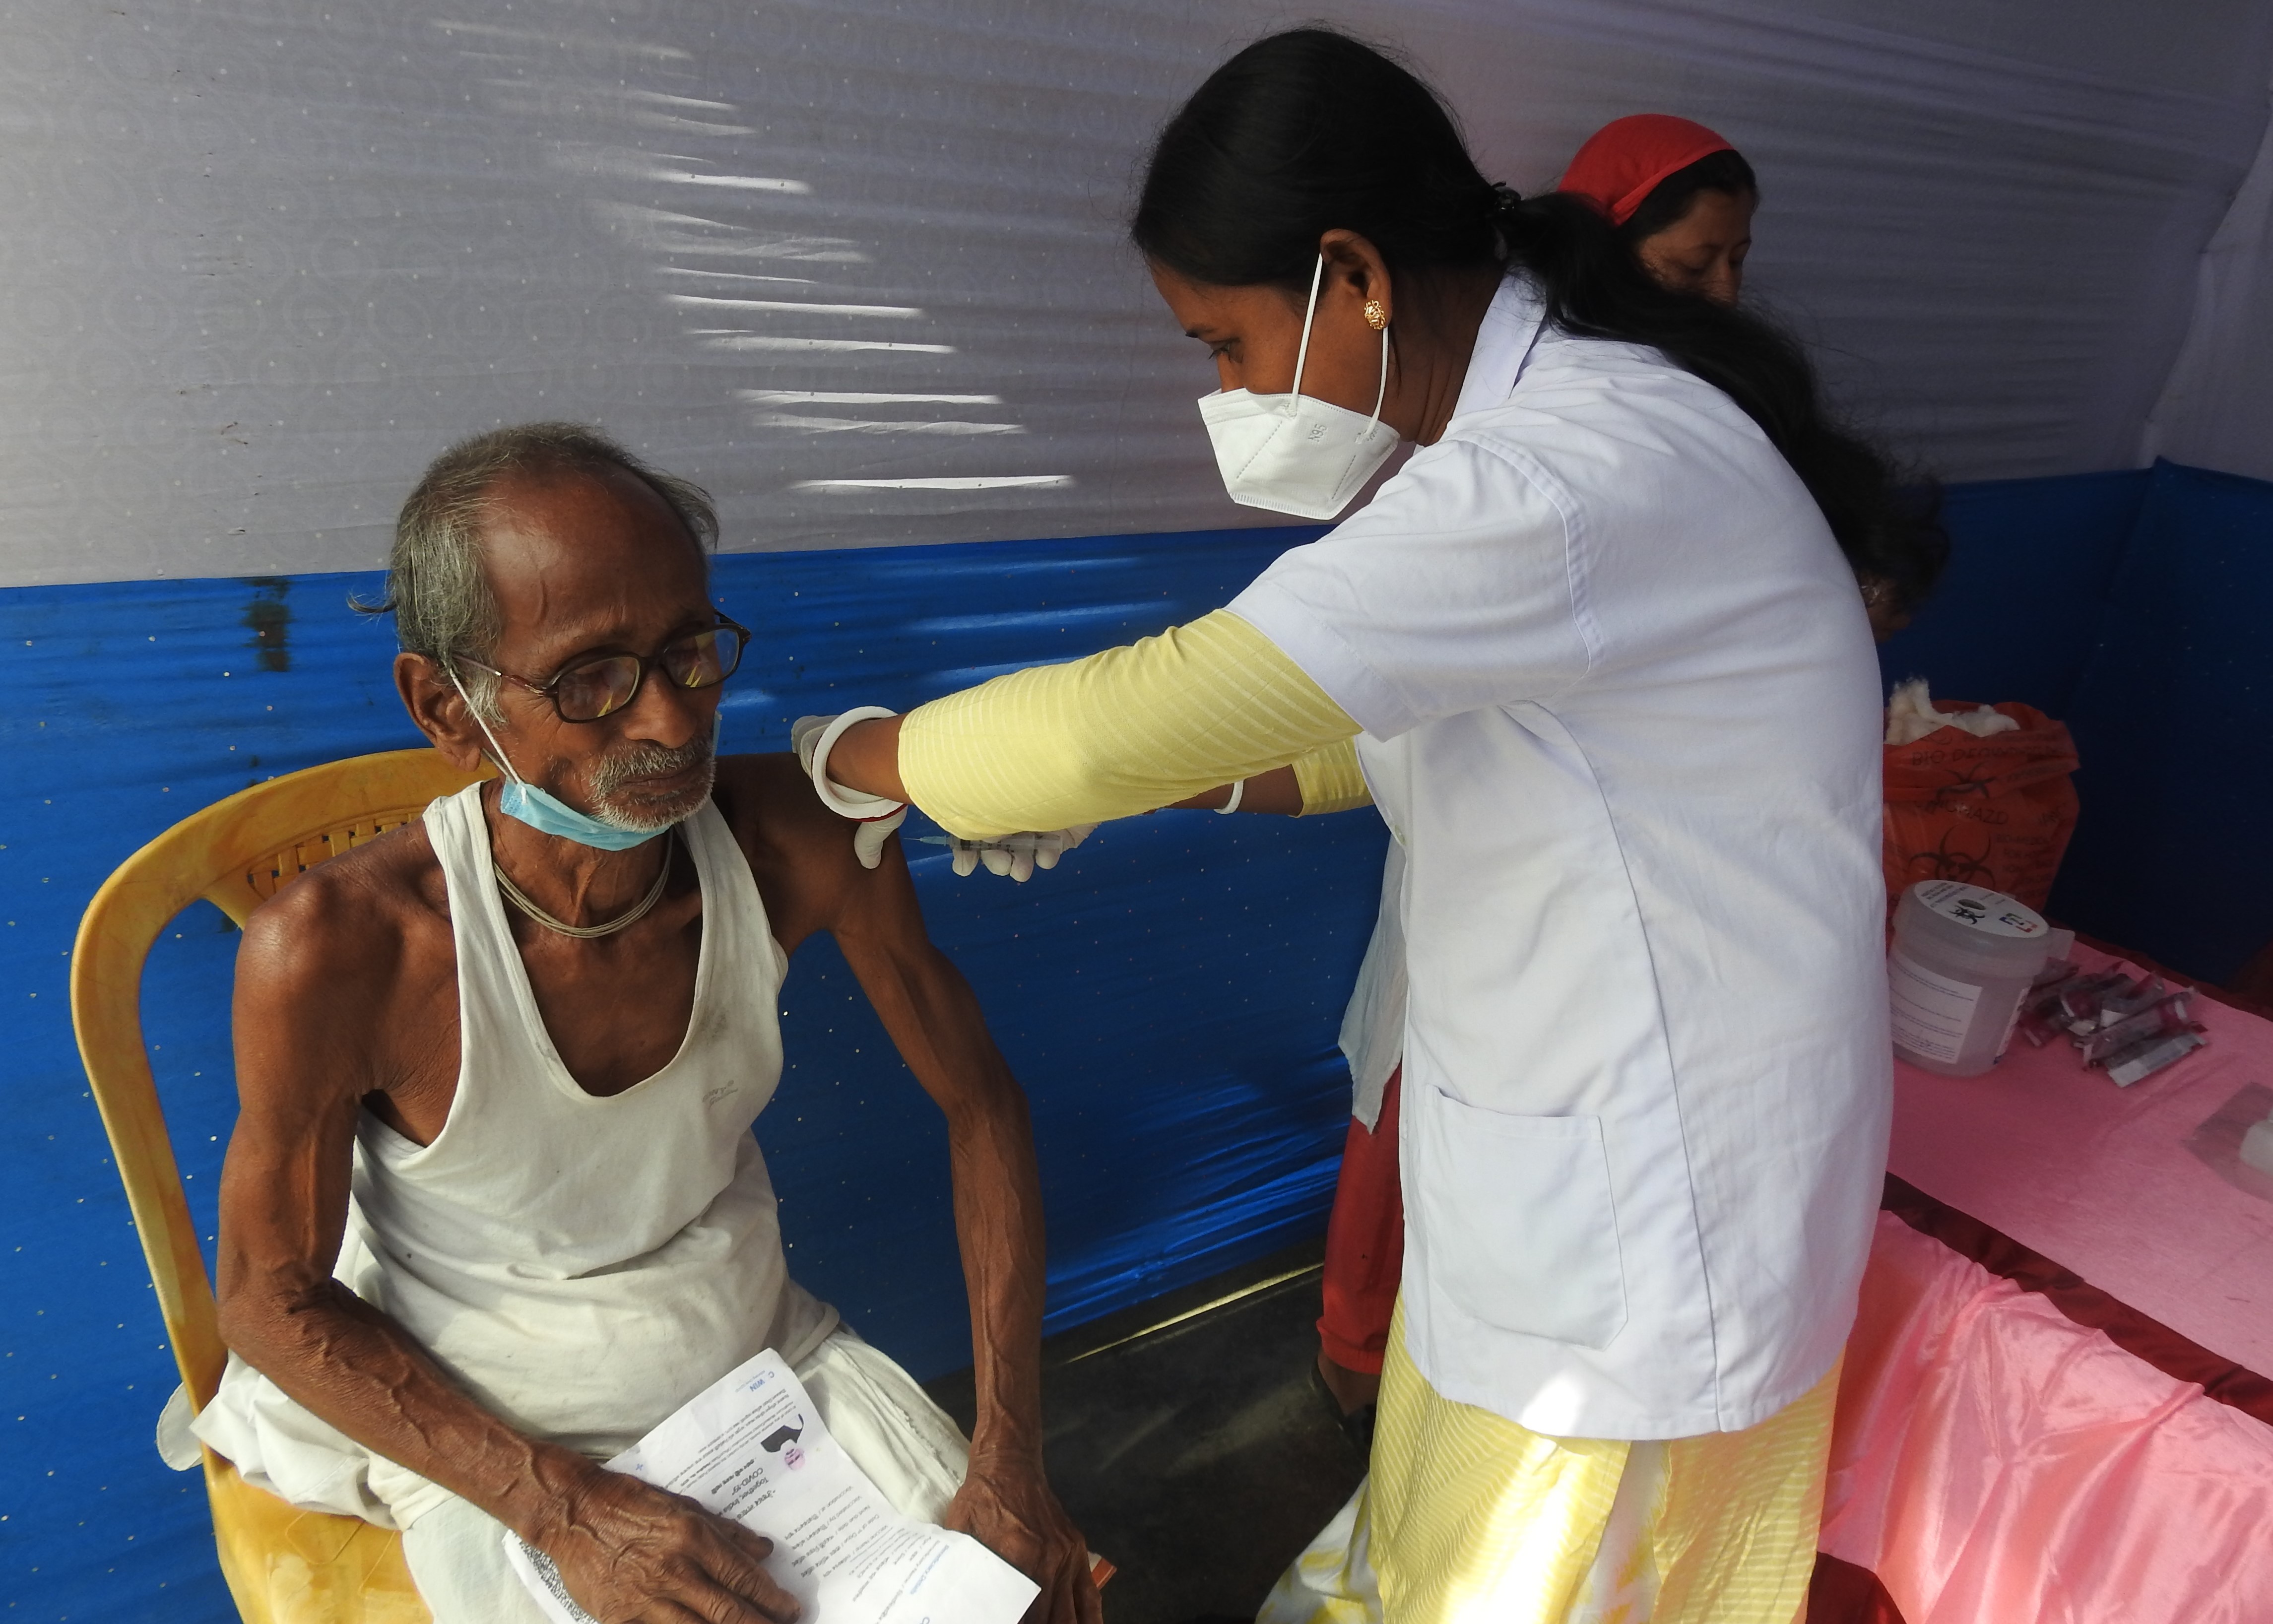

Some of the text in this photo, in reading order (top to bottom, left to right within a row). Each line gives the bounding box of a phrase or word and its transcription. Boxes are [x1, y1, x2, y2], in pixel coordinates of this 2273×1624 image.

[1308, 423, 1327, 443] N95
[748, 1377, 766, 1393] WIN
[722, 1474, 770, 1514] Together, India
